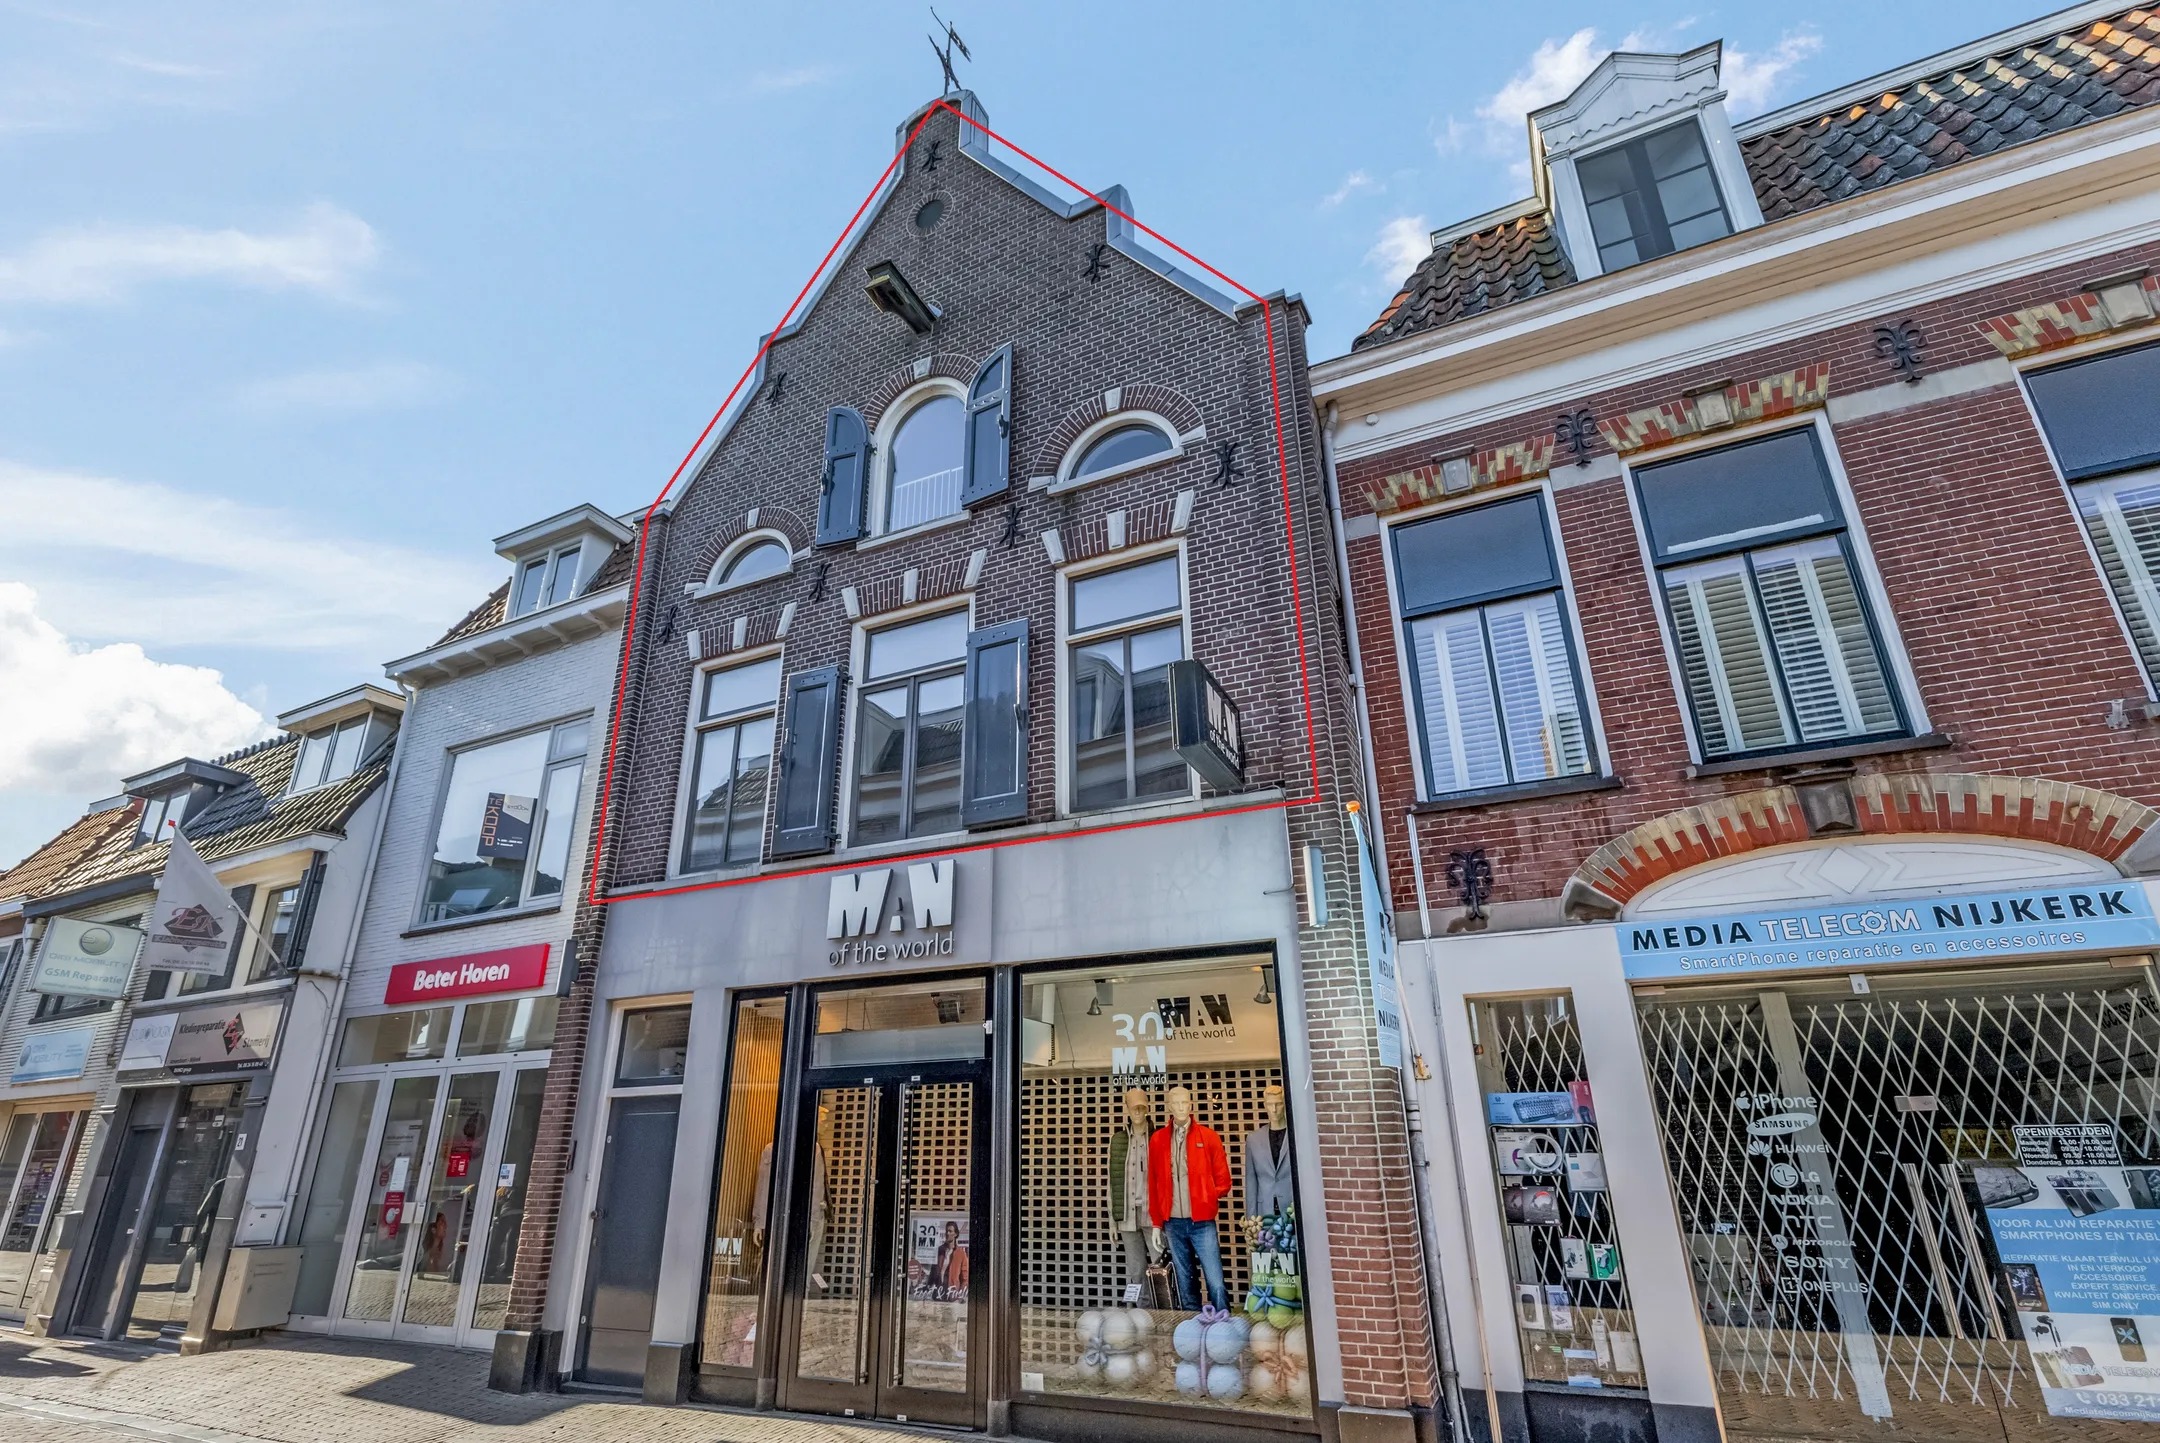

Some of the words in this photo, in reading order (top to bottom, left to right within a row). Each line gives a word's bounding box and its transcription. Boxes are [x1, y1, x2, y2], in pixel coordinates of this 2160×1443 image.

[481, 806, 500, 846] KOOP
[826, 859, 955, 940] MAN
[1632, 921, 1753, 951] MEDIA
[1759, 908, 1921, 942] TELECOM
[1932, 890, 2135, 929] NIJKERK
[829, 942, 851, 966] of
[853, 940, 887, 964] the
[892, 931, 955, 959] world
[1680, 951, 1799, 970] SmartPhone
[1806, 942, 1902, 964] reparatie
[1911, 942, 1937, 955] en
[1946, 931, 2086, 953] accessoires
[45, 968, 71, 979] GSM
[72, 971, 124, 985] Reparatie
[413, 969, 458, 991] Beter
[458, 963, 510, 985] Horen
[1157, 994, 1233, 1028] MAN
[179, 1020, 226, 1035] Kledingreparatie
[1180, 1029, 1199, 1040] the
[1201, 1026, 1236, 1039] world
[242, 1035, 270, 1049] Stomerij
[1112, 1045, 1166, 1074] MAN
[1113, 1074, 1123, 1086] of
[1125, 1075, 1139, 1085] the
[1141, 1074, 1166, 1084] world
[1755, 1093, 1818, 1109] iPhone
[1754, 1120, 1809, 1129] SAMSUNG
[2015, 1126, 2110, 1136] OPENINGSTIJDEN
[1775, 1144, 1830, 1154] HUAWEI
[1800, 1172, 1820, 1183] LG
[1769, 1194, 1835, 1206] NOKIA
[1992, 1219, 2032, 1228] VOOR
[2035, 1219, 2052, 1228] AL
[2054, 1220, 2076, 1228] UW
[2080, 1219, 2154, 1229] REPARATIE
[2000, 1231, 2102, 1241] SMARTPHONES
[2105, 1232, 2125, 1241] EN
[1792, 1239, 1857, 1247] MOTOROLA
[1784, 1256, 1851, 1269] SONY
[2003, 1254, 2060, 1262] REPARATIE
[2061, 1255, 2096, 1263] KLAAR
[2098, 1255, 2142, 1263] TERWIJL
[2098, 1265, 2147, 1273] VERKOOP
[1276, 1276, 1296, 1284] world
[2073, 1274, 2146, 1282] ACCESSOIRES
[1803, 1281, 1869, 1294] ONEPLUS
[2071, 1282, 2109, 1290] EXPERT
[2112, 1283, 2157, 1291] SERVICE
[2054, 1291, 2109, 1299] KWALITEIT
[2092, 1301, 2110, 1309] SIM
[2113, 1301, 2139, 1310] ONLY
[2096, 1392, 2131, 1407] 033
[2134, 1394, 2160, 1408] 21
